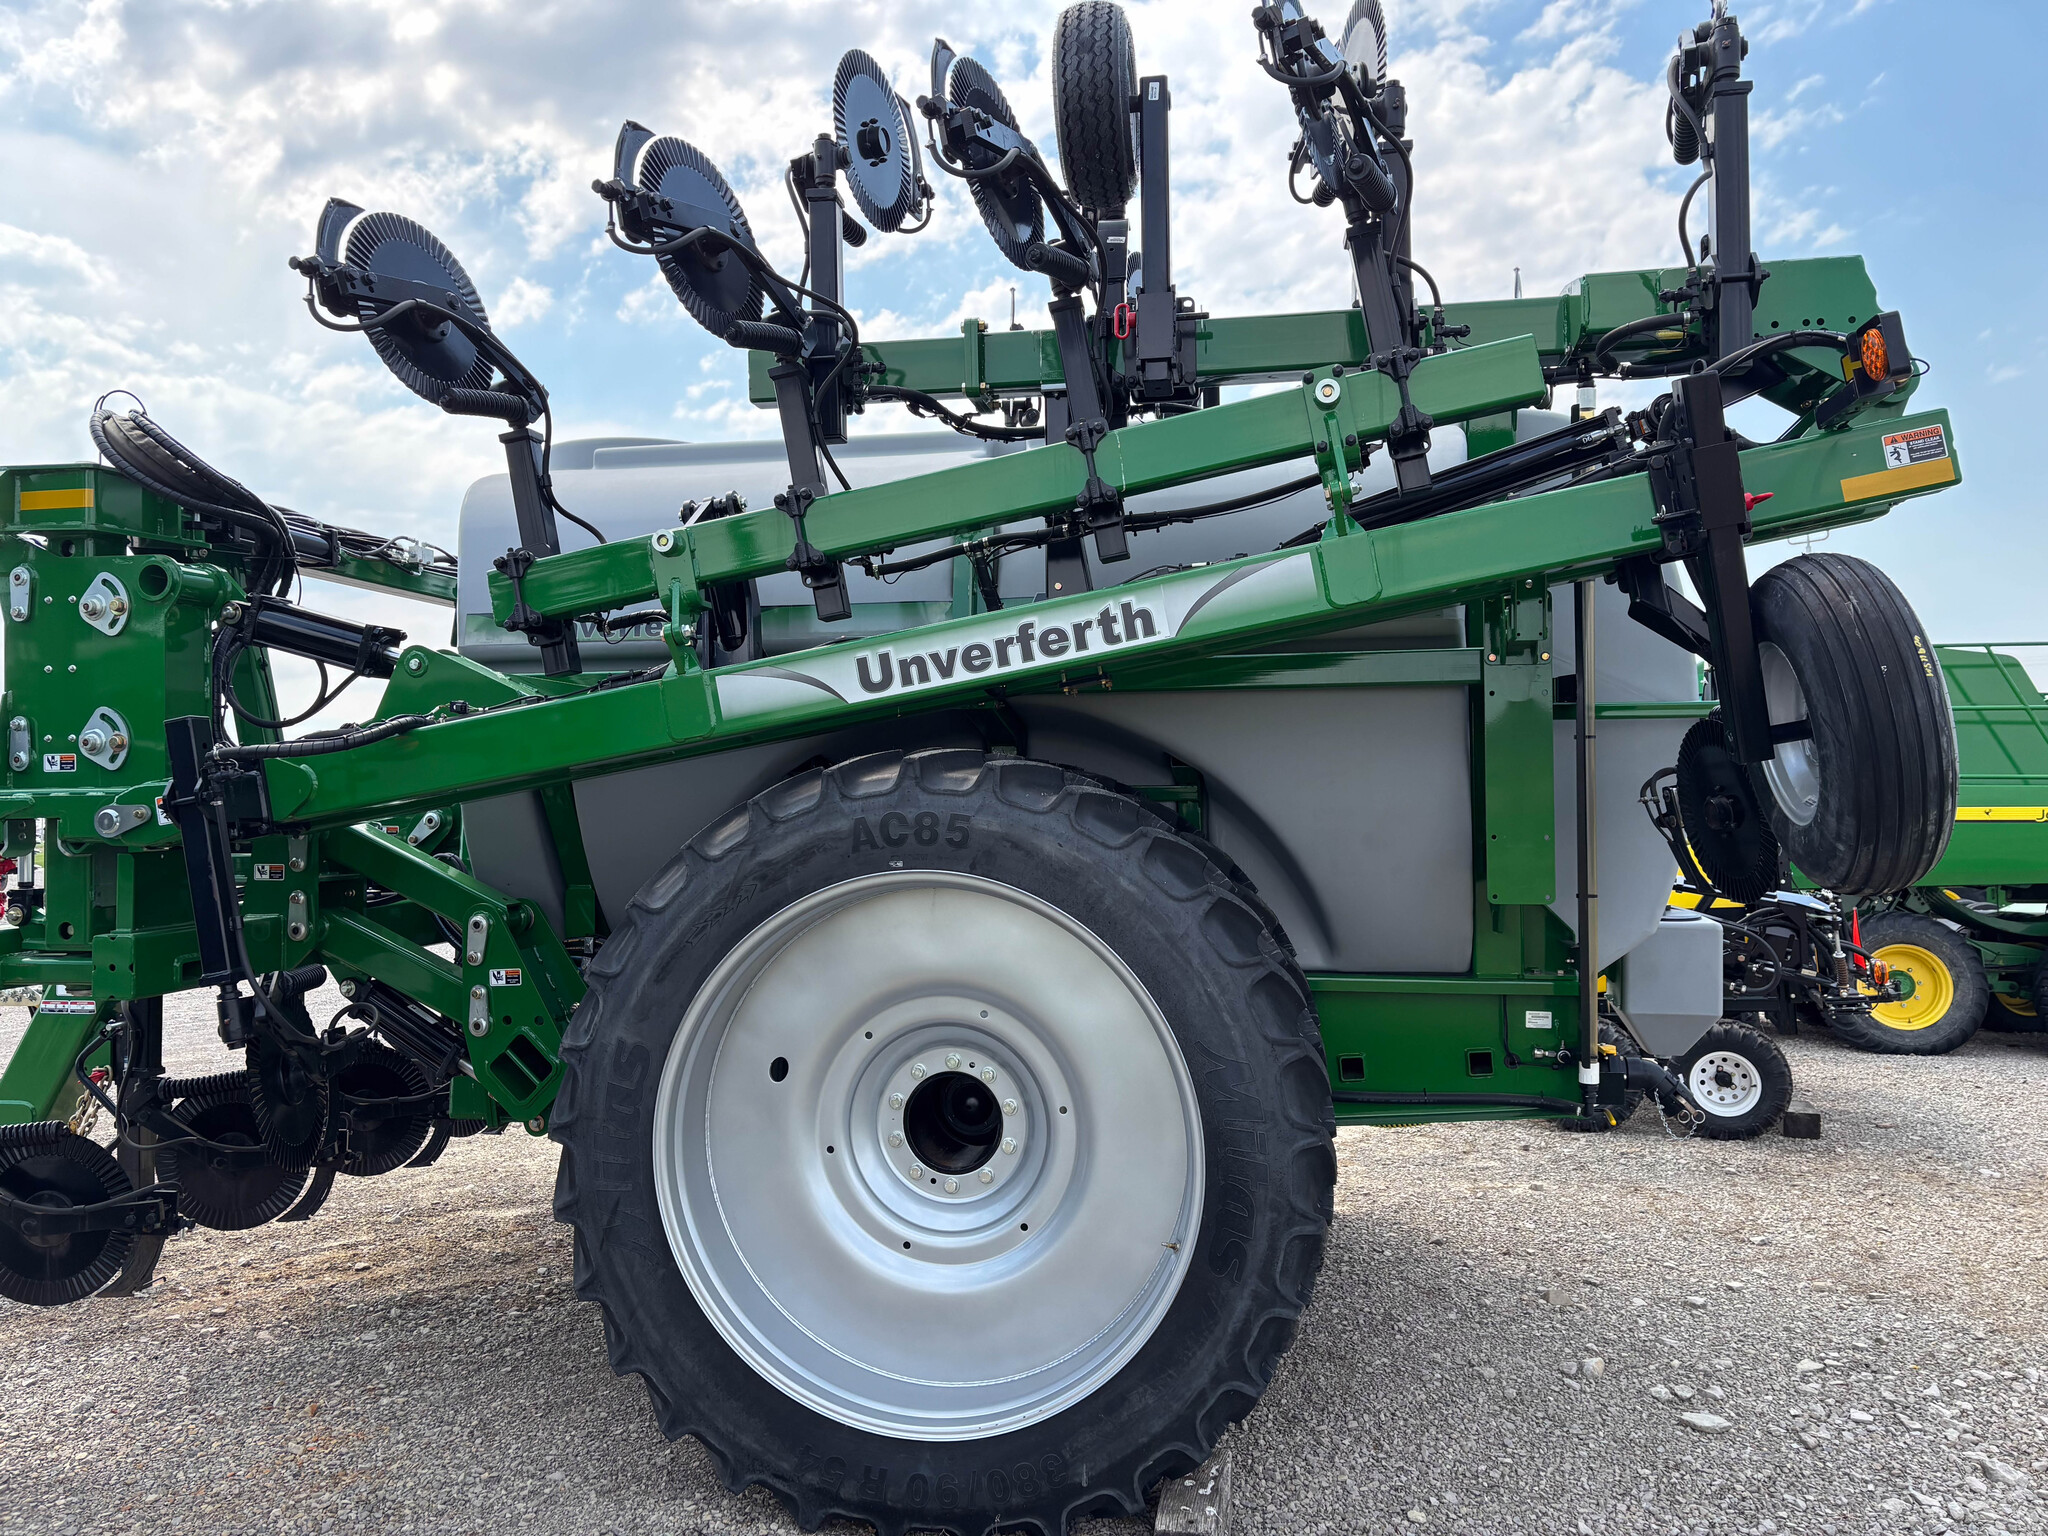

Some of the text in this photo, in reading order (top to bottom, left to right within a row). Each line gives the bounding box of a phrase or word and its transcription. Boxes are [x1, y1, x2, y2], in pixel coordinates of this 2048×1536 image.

[1900, 428, 1940, 441] WARNING
[854, 600, 1157, 693] Unverferth
[851, 811, 972, 854] AC85
[1193, 1040, 1269, 1284] Mitas
[856, 1464, 888, 1502] R
[905, 1453, 1068, 1509] 380/90
